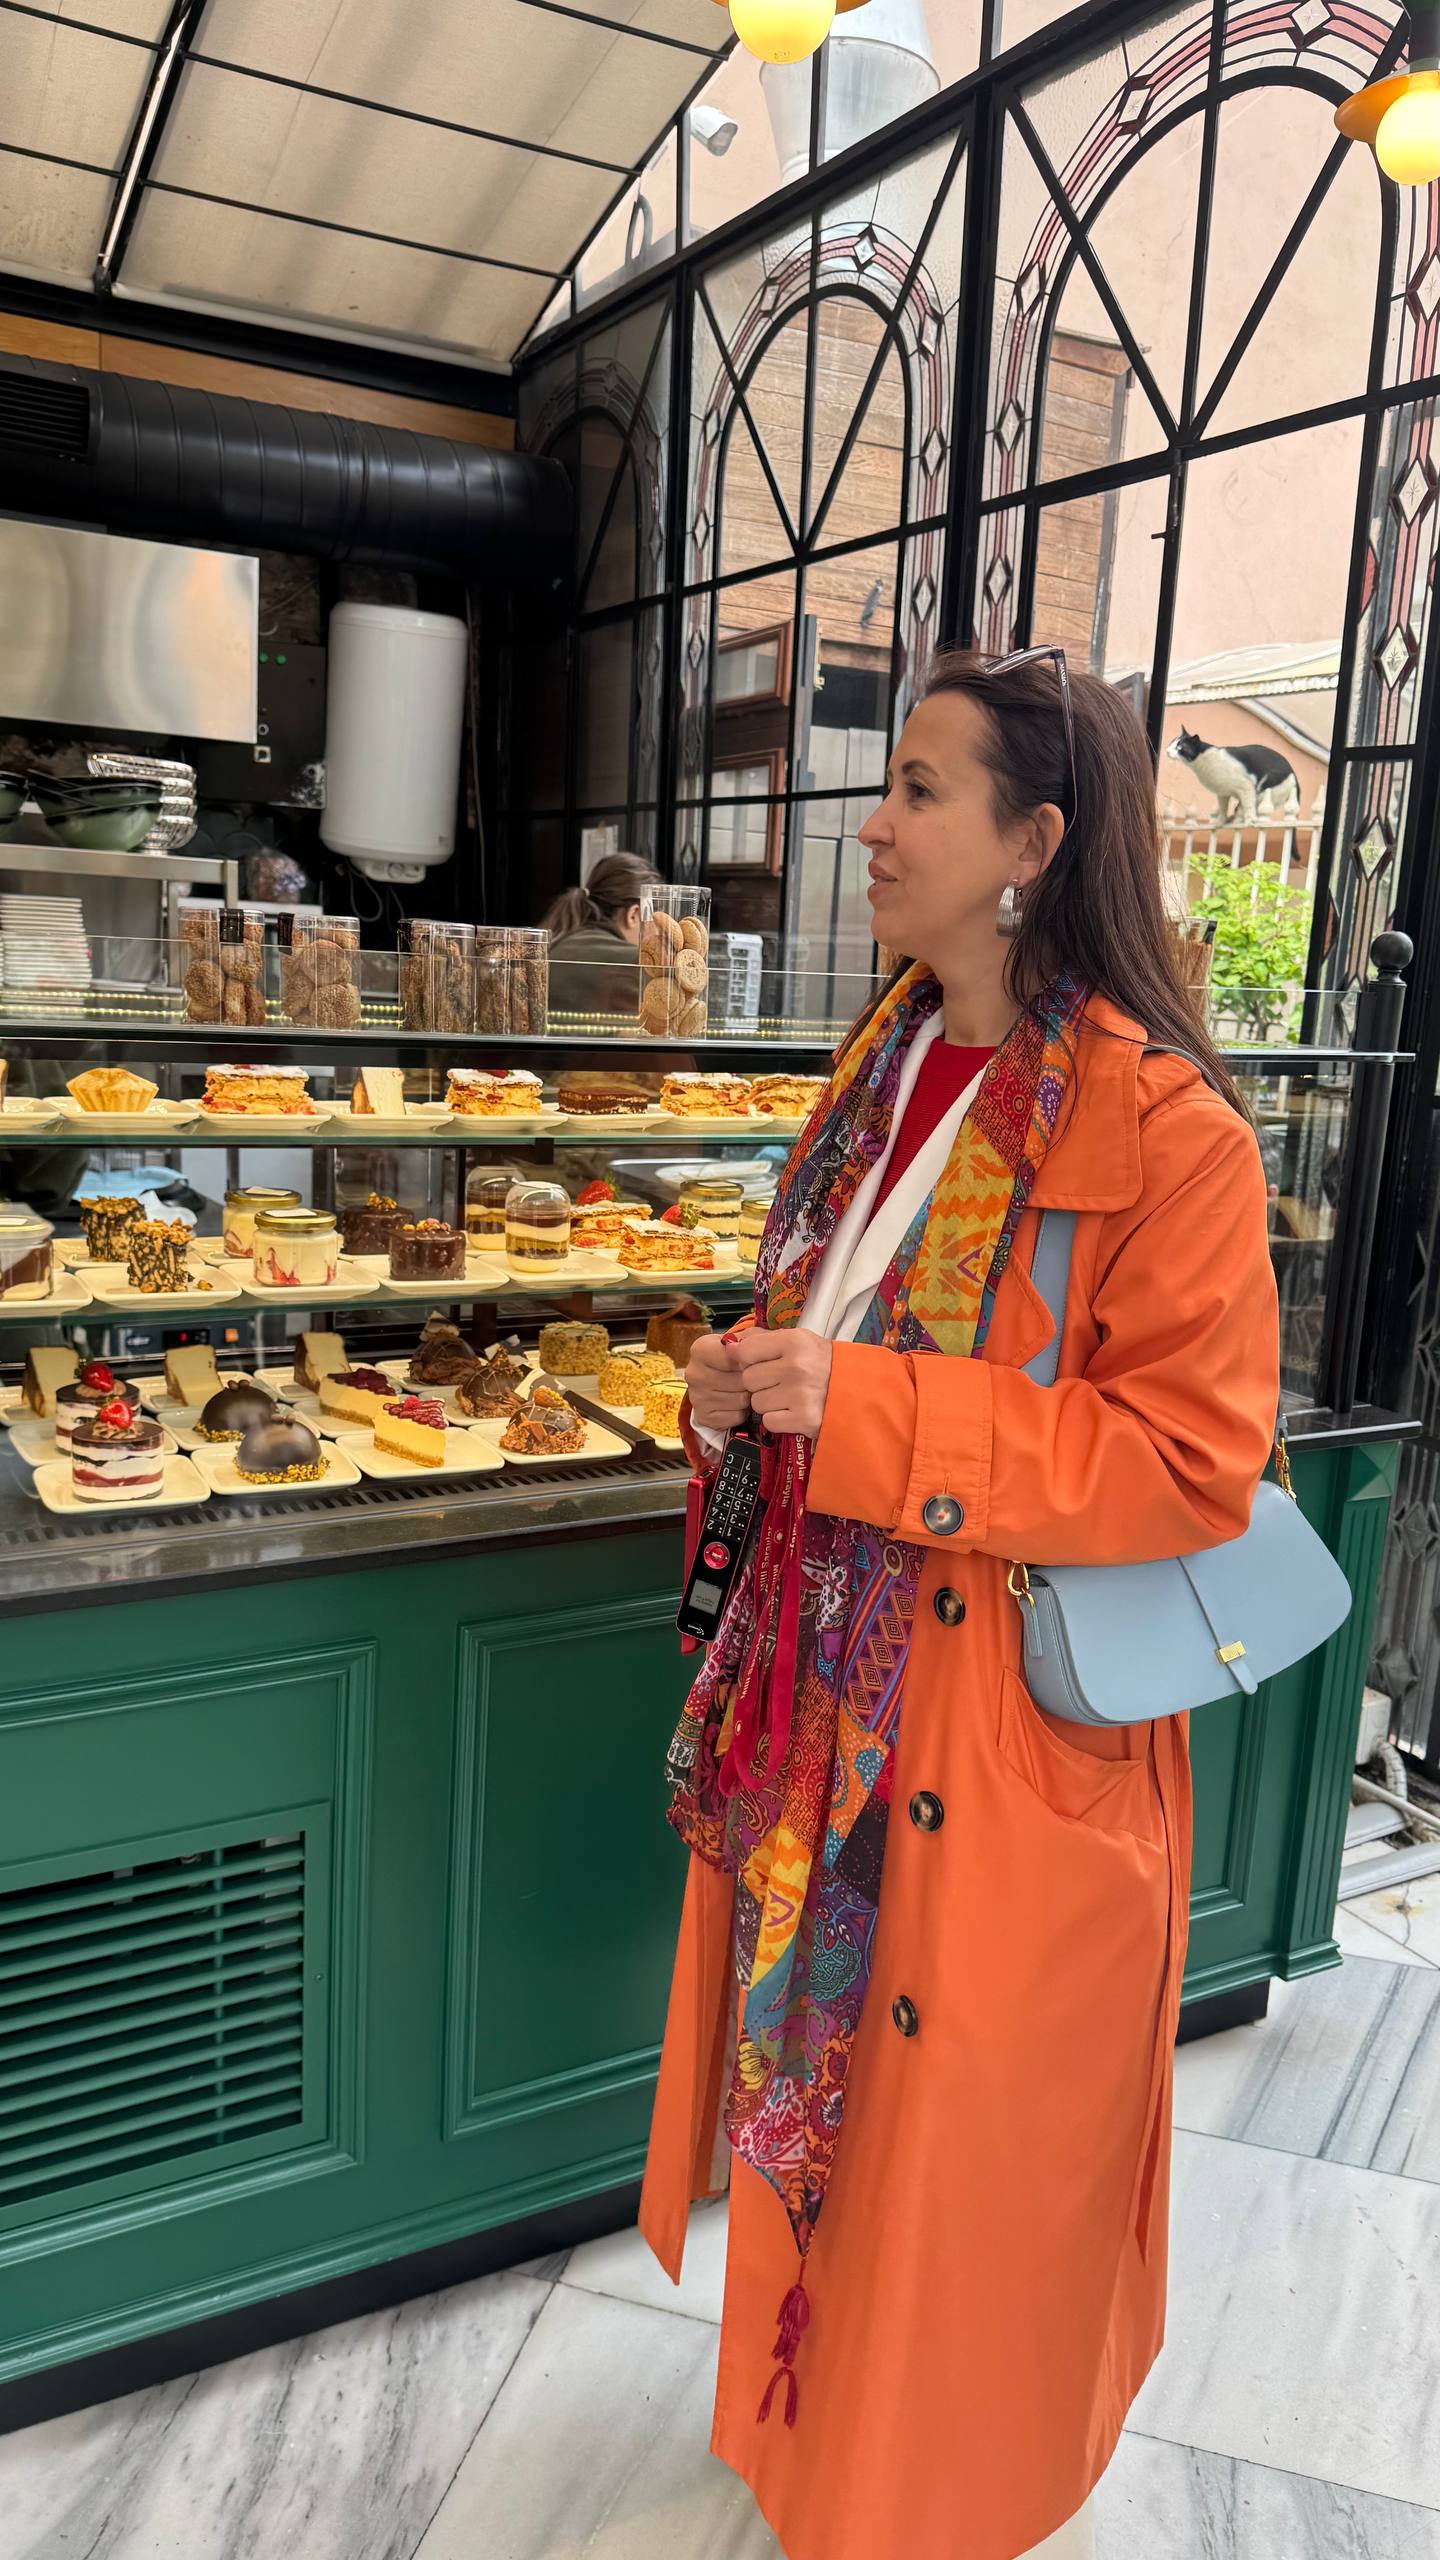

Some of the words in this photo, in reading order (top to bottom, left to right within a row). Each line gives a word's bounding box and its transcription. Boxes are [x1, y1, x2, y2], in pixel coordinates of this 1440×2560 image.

[726, 1453, 734, 1464] C
[795, 1434, 808, 1481] Saraylar
[741, 1475, 748, 1485] 9
[718, 1480, 726, 1491] 8
[715, 1493, 722, 1503] 6
[737, 1488, 744, 1498] 7
[733, 1501, 741, 1511] 5
[711, 1506, 719, 1517] 4
[729, 1513, 738, 1524] 3
[706, 1520, 715, 1530] 2
